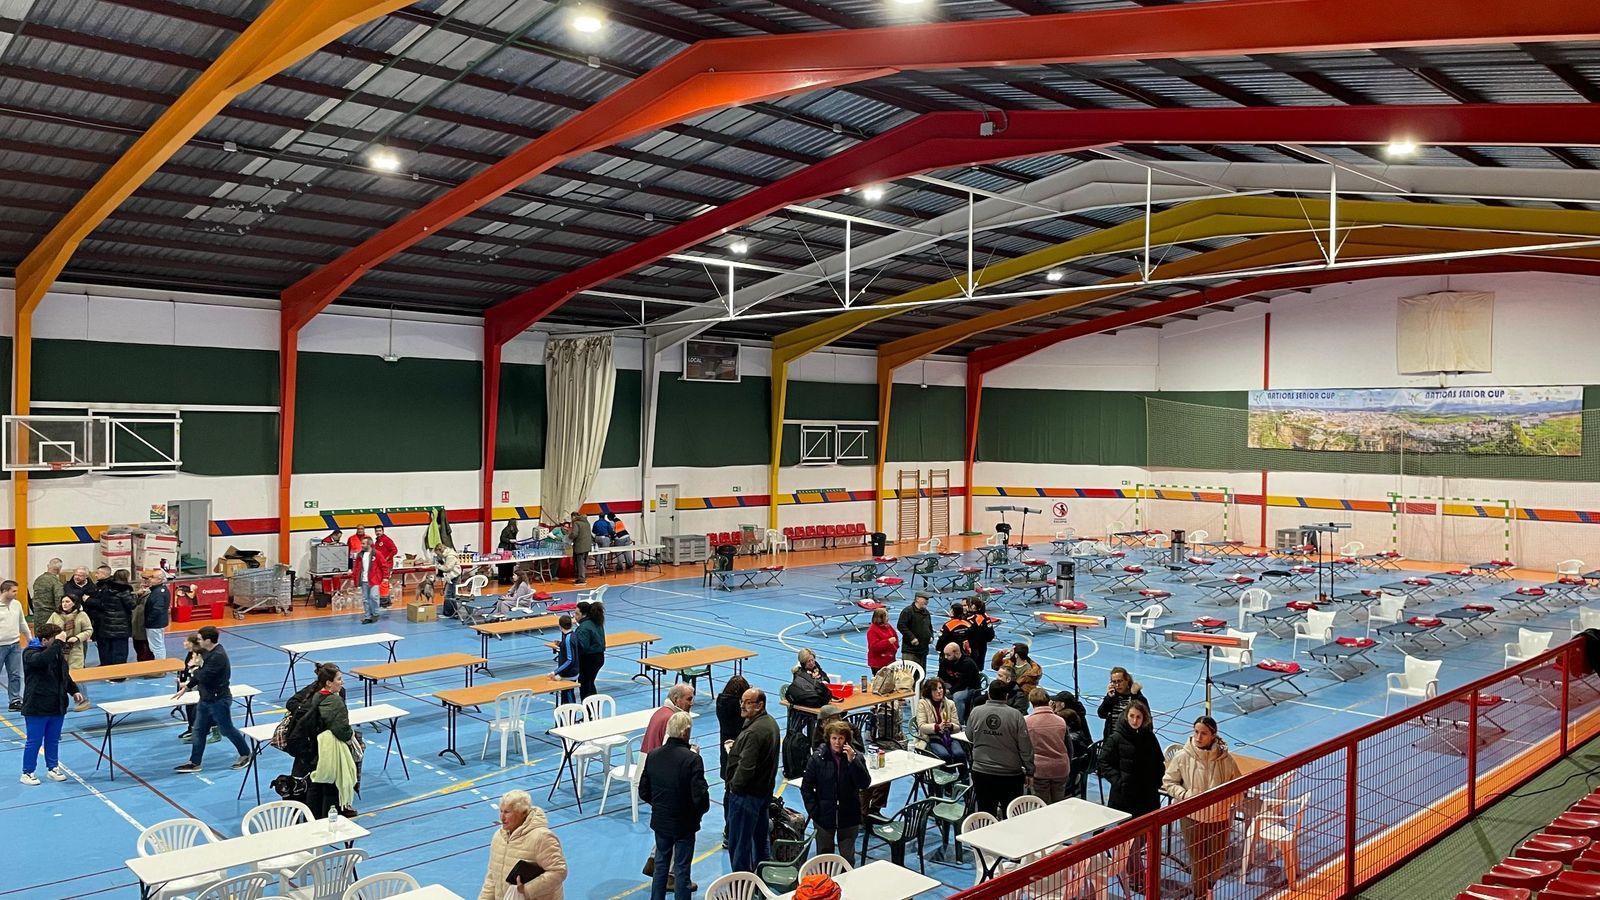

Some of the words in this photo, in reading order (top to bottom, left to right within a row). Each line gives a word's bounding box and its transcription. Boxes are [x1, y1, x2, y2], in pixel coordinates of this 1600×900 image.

[1424, 390, 1457, 399] NATIONS
[1459, 390, 1486, 398] SENIOR
[1488, 390, 1505, 398] CUP
